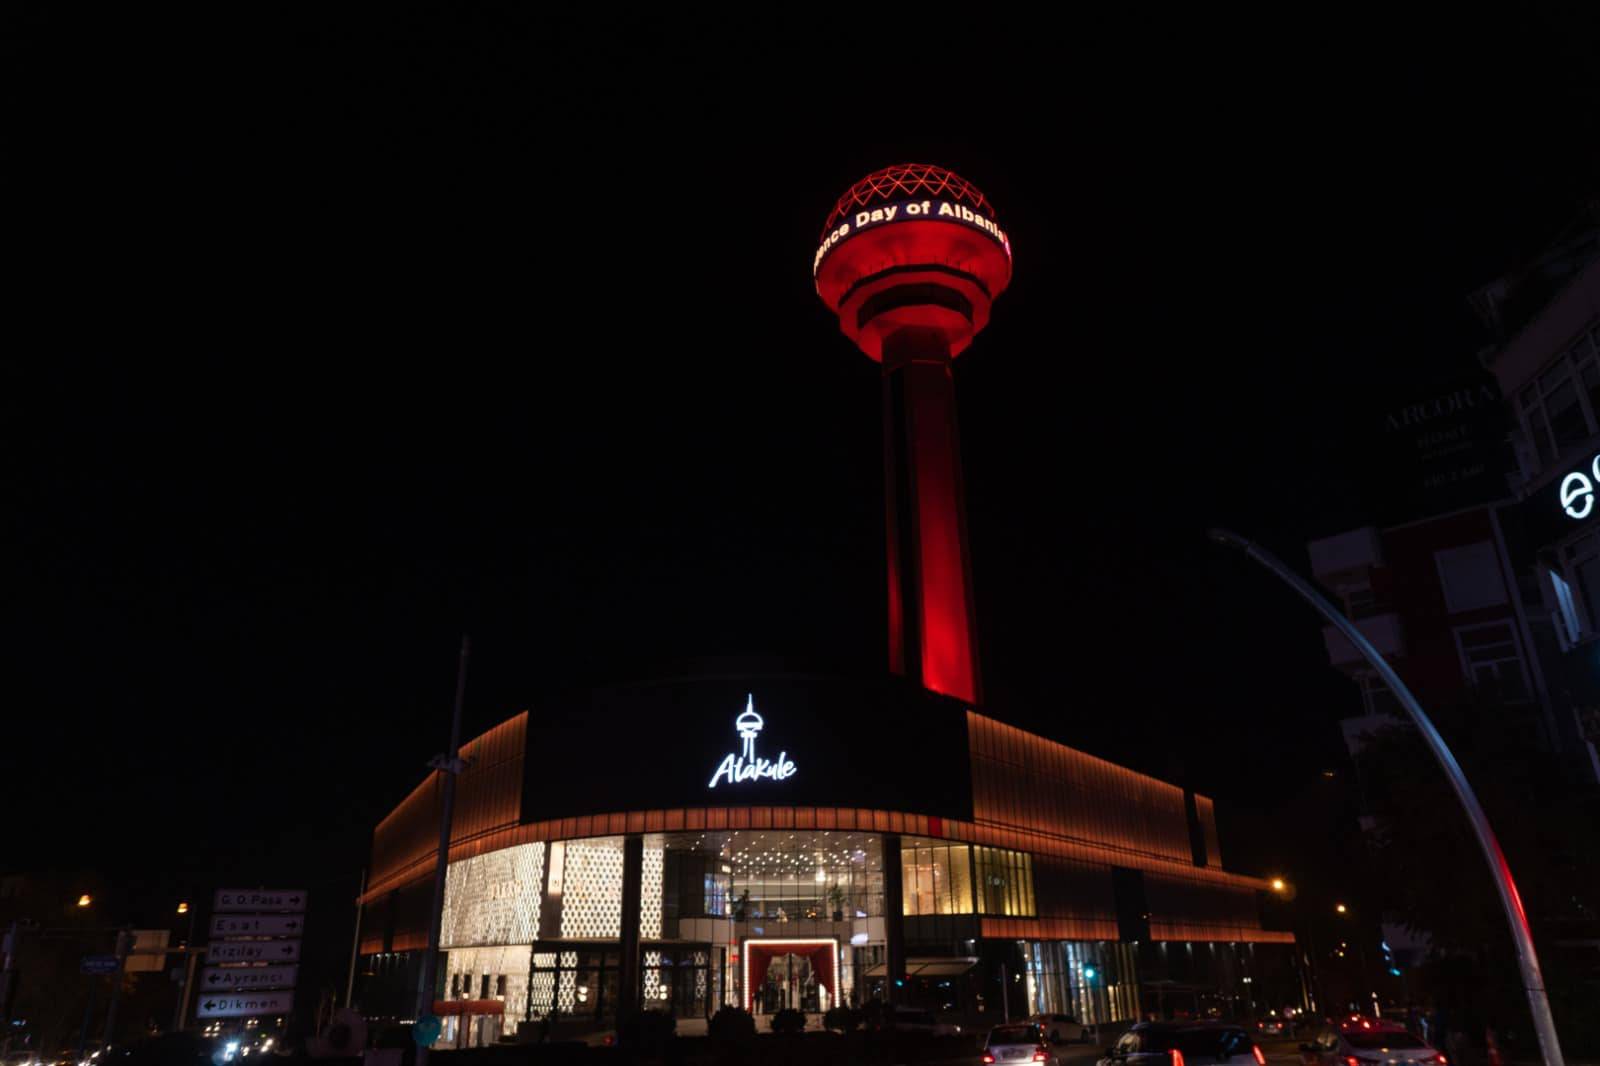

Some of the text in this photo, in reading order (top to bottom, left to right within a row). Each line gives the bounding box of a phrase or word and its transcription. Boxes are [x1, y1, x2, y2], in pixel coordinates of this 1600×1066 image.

[856, 204, 898, 228] Day
[906, 201, 931, 215] of
[215, 919, 260, 931] Esat
[218, 999, 278, 1010] Dikmen
